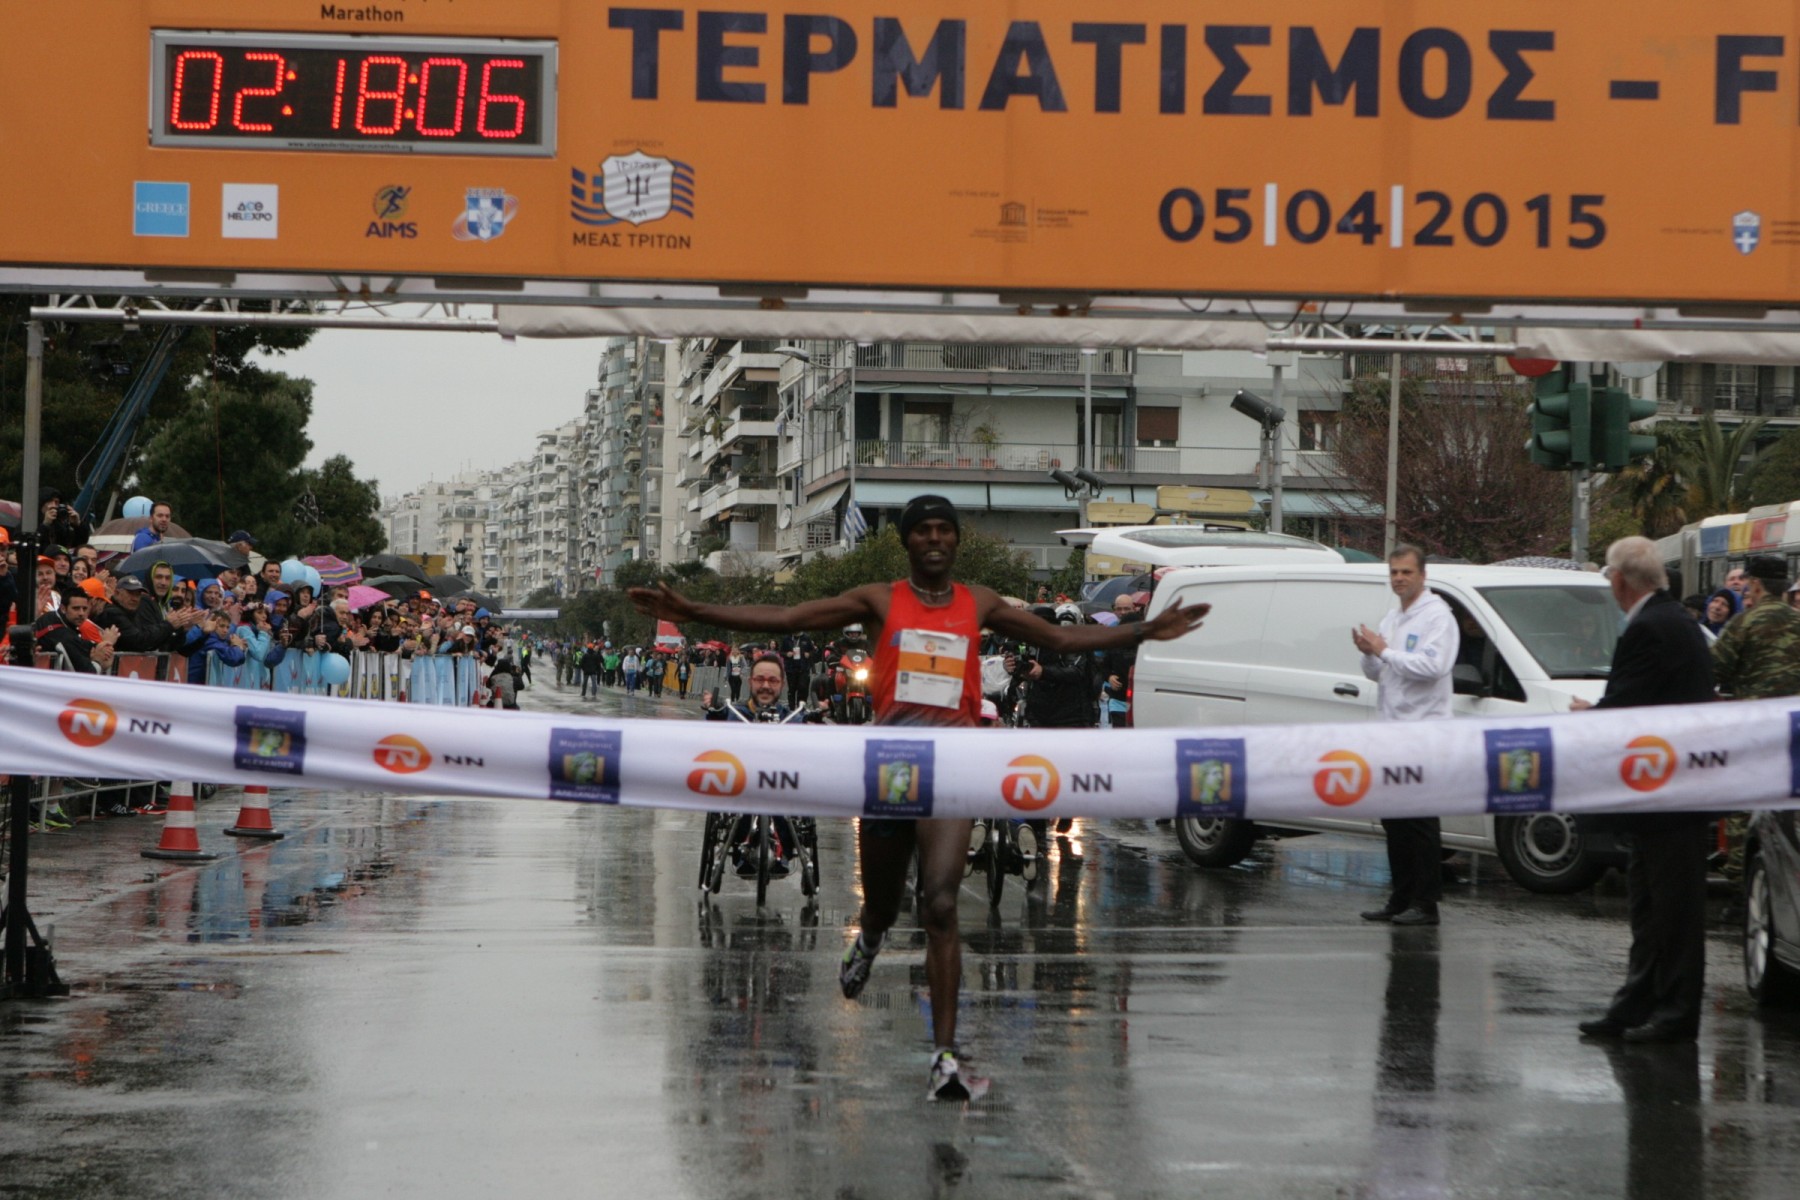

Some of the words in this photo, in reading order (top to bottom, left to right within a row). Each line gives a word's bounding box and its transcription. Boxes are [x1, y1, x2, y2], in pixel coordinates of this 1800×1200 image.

[321, 4, 404, 22] Marathon
[607, 7, 1556, 122] ΤΕΡΜΑΤΙΣΜΟΣ
[1714, 34, 1800, 125] F
[171, 51, 525, 138] 02:18:06
[137, 202, 187, 214] GREECE
[227, 212, 273, 222] HELEXPO
[365, 221, 419, 239] AIMS
[572, 231, 622, 248] ΜΕΑΣ
[628, 233, 692, 250] ΤΡΙΤΩΝ
[929, 655, 937, 670] 1
[129, 717, 171, 736] NN
[443, 754, 485, 768] NN
[1687, 749, 1729, 770] NN
[757, 769, 800, 790] NN
[1071, 773, 1113, 793] NN
[1382, 765, 1423, 786] NN
